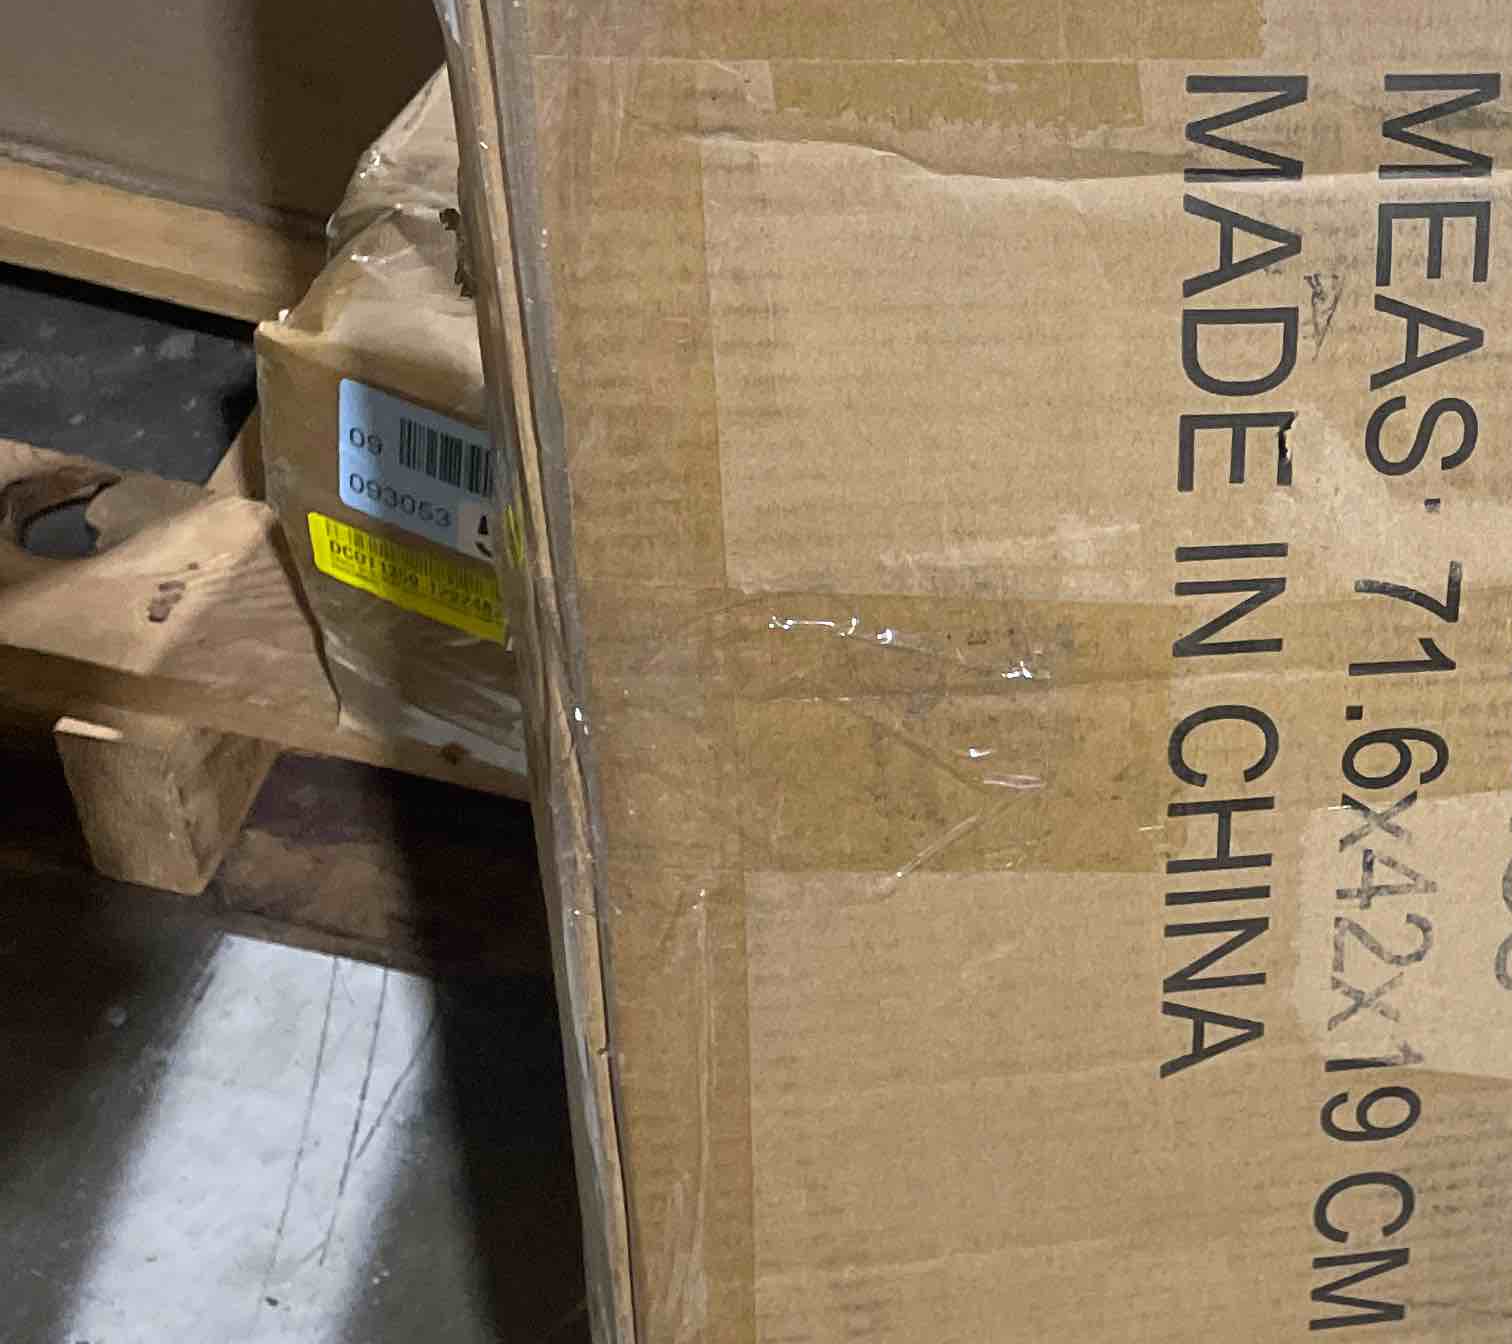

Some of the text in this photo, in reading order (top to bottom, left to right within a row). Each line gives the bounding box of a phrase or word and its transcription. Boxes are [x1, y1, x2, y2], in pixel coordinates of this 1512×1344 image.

[349, 427, 384, 456] 09
[1159, 74, 1309, 1079] MADE IN CHINA
